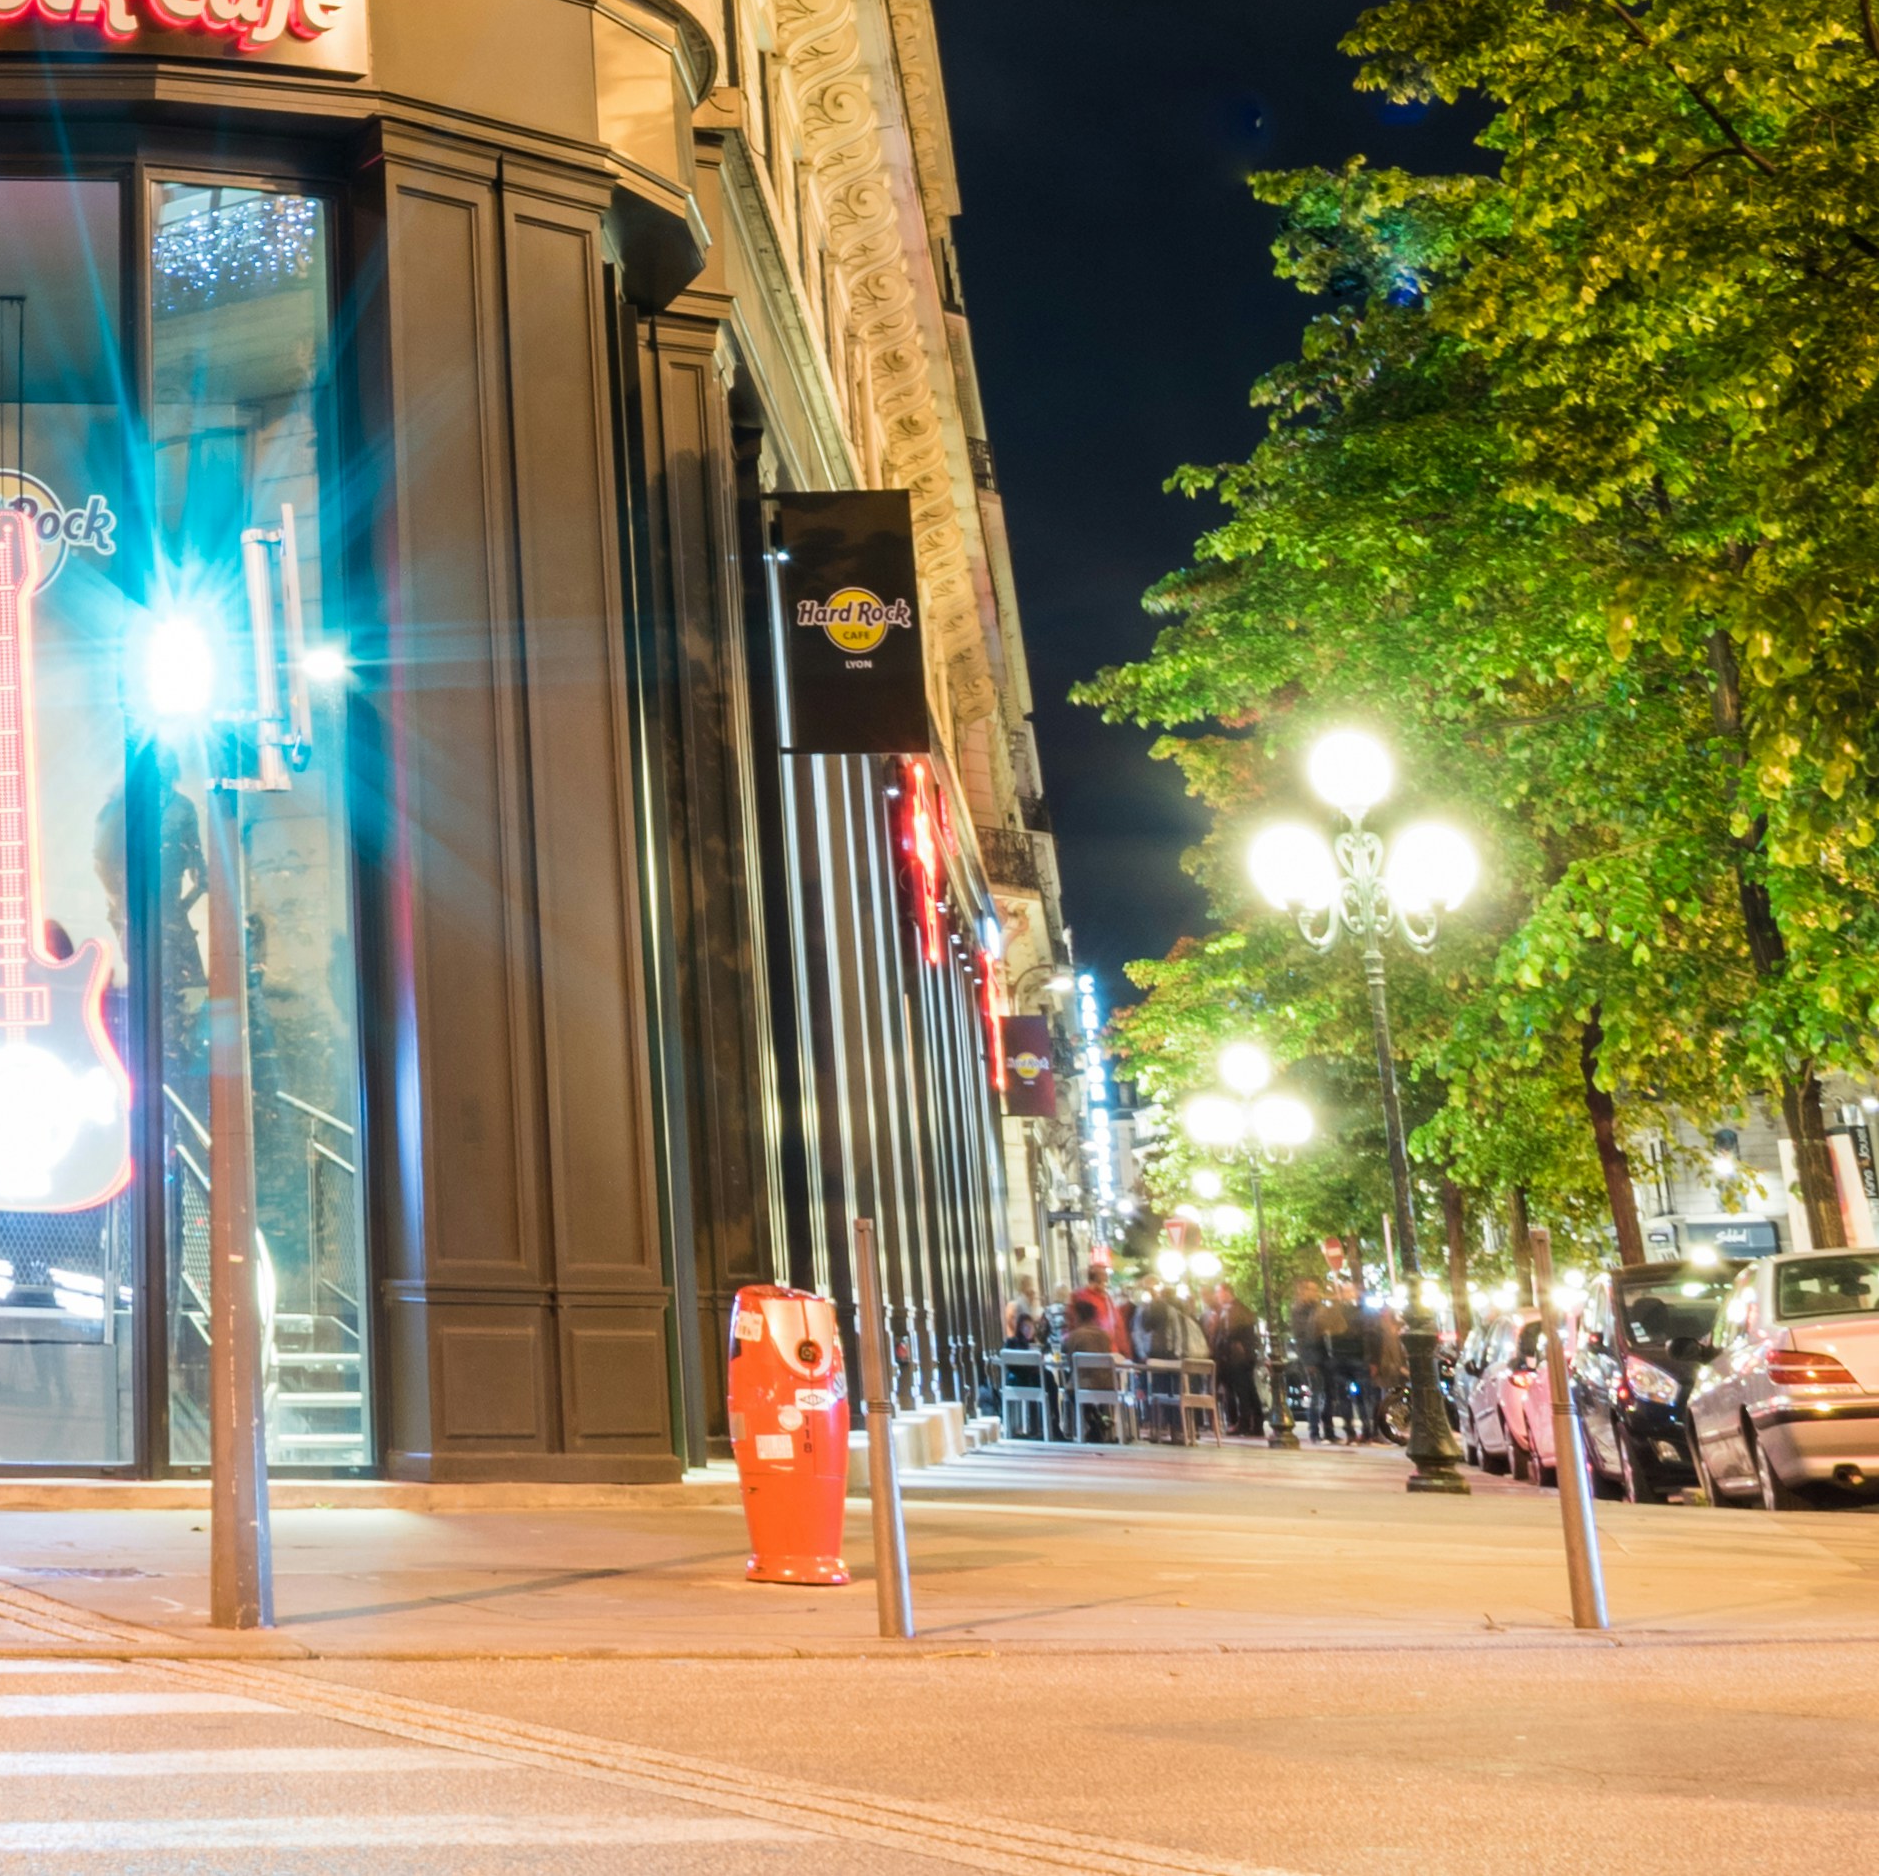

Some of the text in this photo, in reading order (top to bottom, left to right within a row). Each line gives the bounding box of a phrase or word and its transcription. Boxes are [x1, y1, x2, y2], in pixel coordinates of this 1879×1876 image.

[797, 598, 912, 629] Hard Rock
[842, 631, 870, 641] CAFE
[845, 660, 873, 669] LYON
